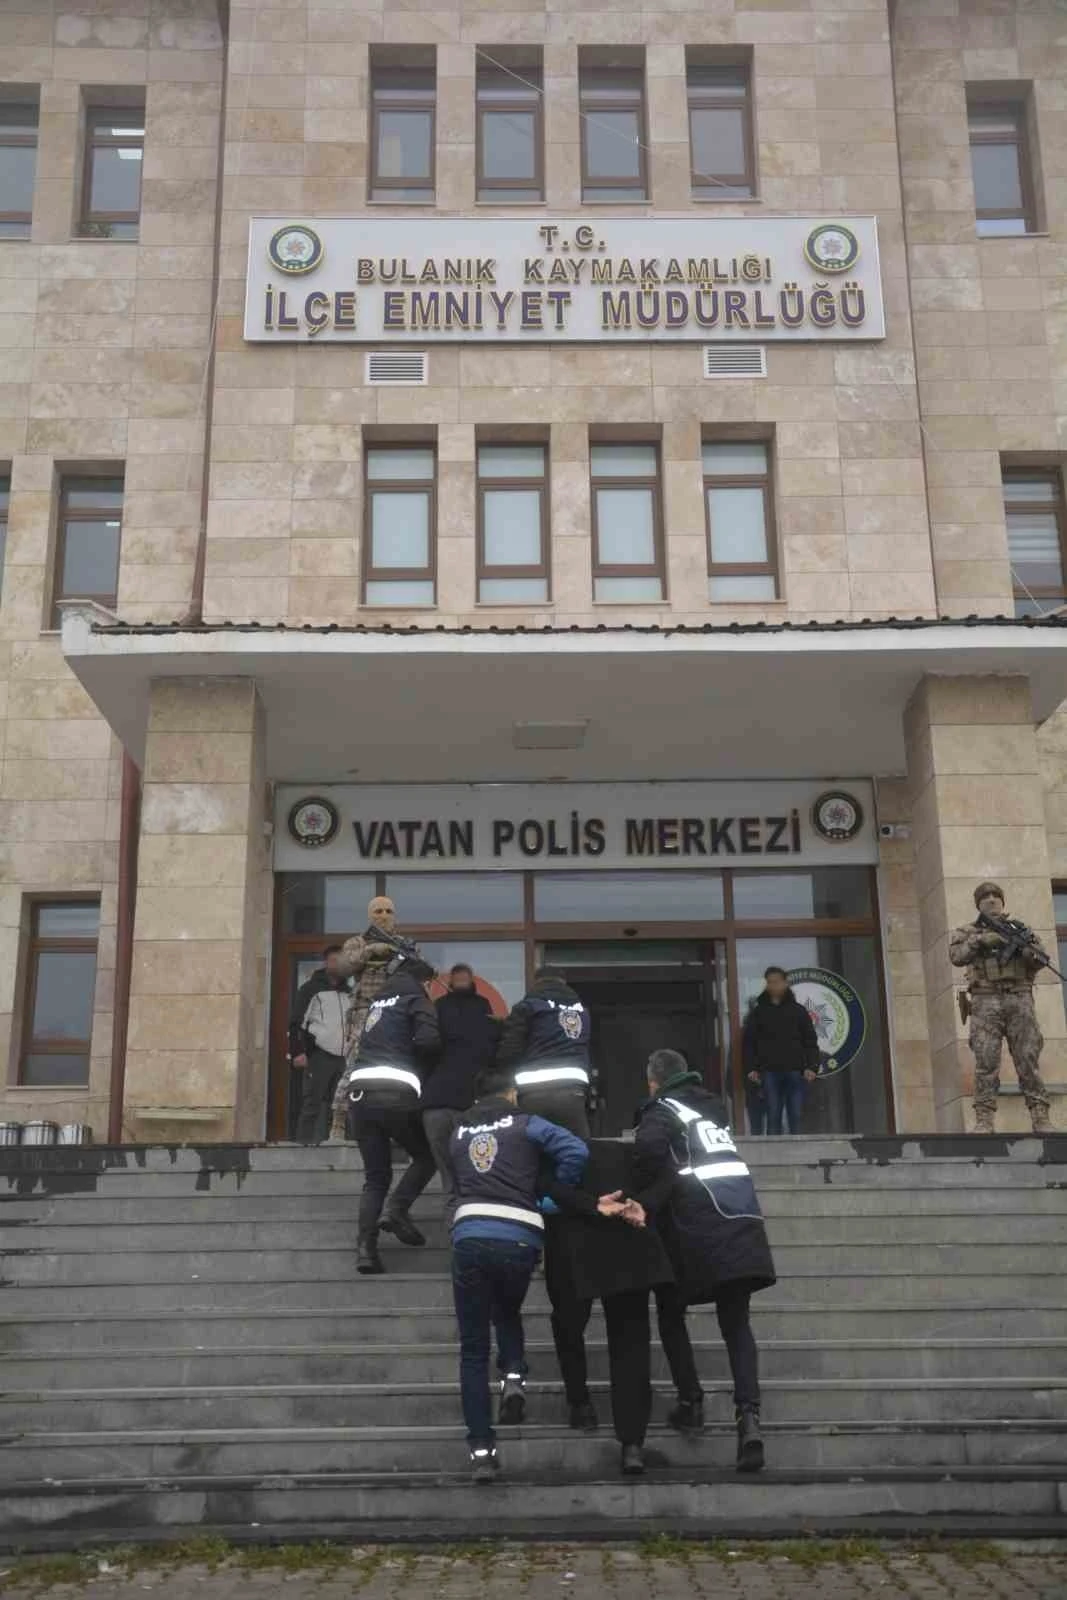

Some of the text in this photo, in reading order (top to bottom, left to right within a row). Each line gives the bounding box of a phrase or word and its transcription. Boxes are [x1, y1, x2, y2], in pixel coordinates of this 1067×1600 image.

[356, 256, 772, 285] BULANIK KAYMAKAMLIĞI
[264, 281, 866, 336] İLÇE EMNİYET MÜDÜRLÜĞÜ
[353, 808, 803, 858] VATAN POLİS MERKEZİ
